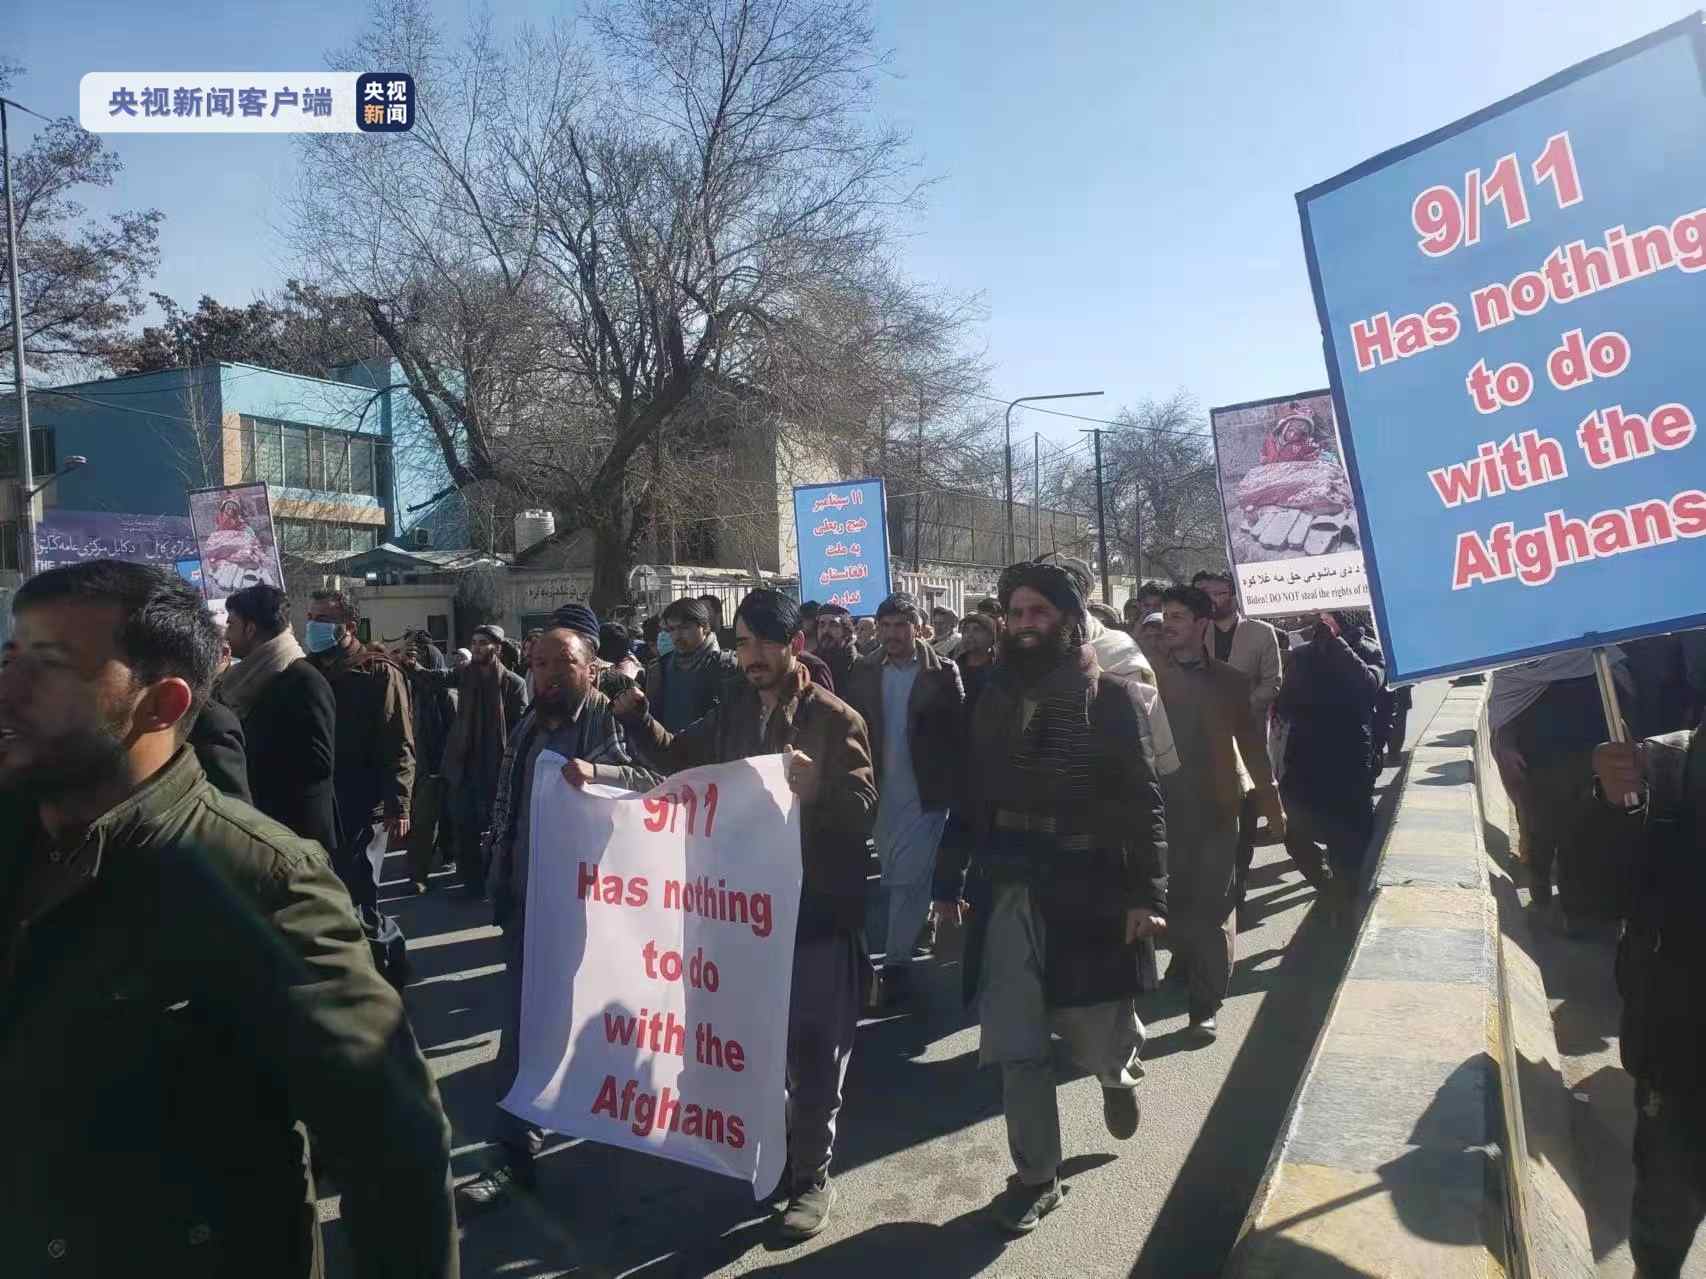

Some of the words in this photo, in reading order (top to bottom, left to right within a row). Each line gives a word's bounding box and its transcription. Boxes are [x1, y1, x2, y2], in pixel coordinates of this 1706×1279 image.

[1412, 130, 1583, 257] 9/11
[1350, 302, 1460, 372] Has
[1472, 208, 1706, 333] nothing
[1466, 358, 1534, 414] to
[1547, 328, 1631, 391] do
[1428, 430, 1569, 508] with
[1578, 403, 1696, 469] the
[1452, 490, 1706, 590] Afghans
[1269, 591, 1281, 603] DO
[1281, 590, 1300, 602] NOT
[1301, 588, 1317, 600] steal
[1318, 587, 1329, 599] the
[1331, 584, 1351, 598] rights
[1353, 584, 1363, 594] of
[643, 783, 718, 838] 9/11
[576, 862, 648, 907] Has
[664, 878, 773, 937] nothing
[642, 939, 683, 982] to
[688, 947, 720, 993] do
[603, 1008, 685, 1057] with
[695, 1022, 745, 1072] the
[590, 1074, 746, 1149] Afghans
